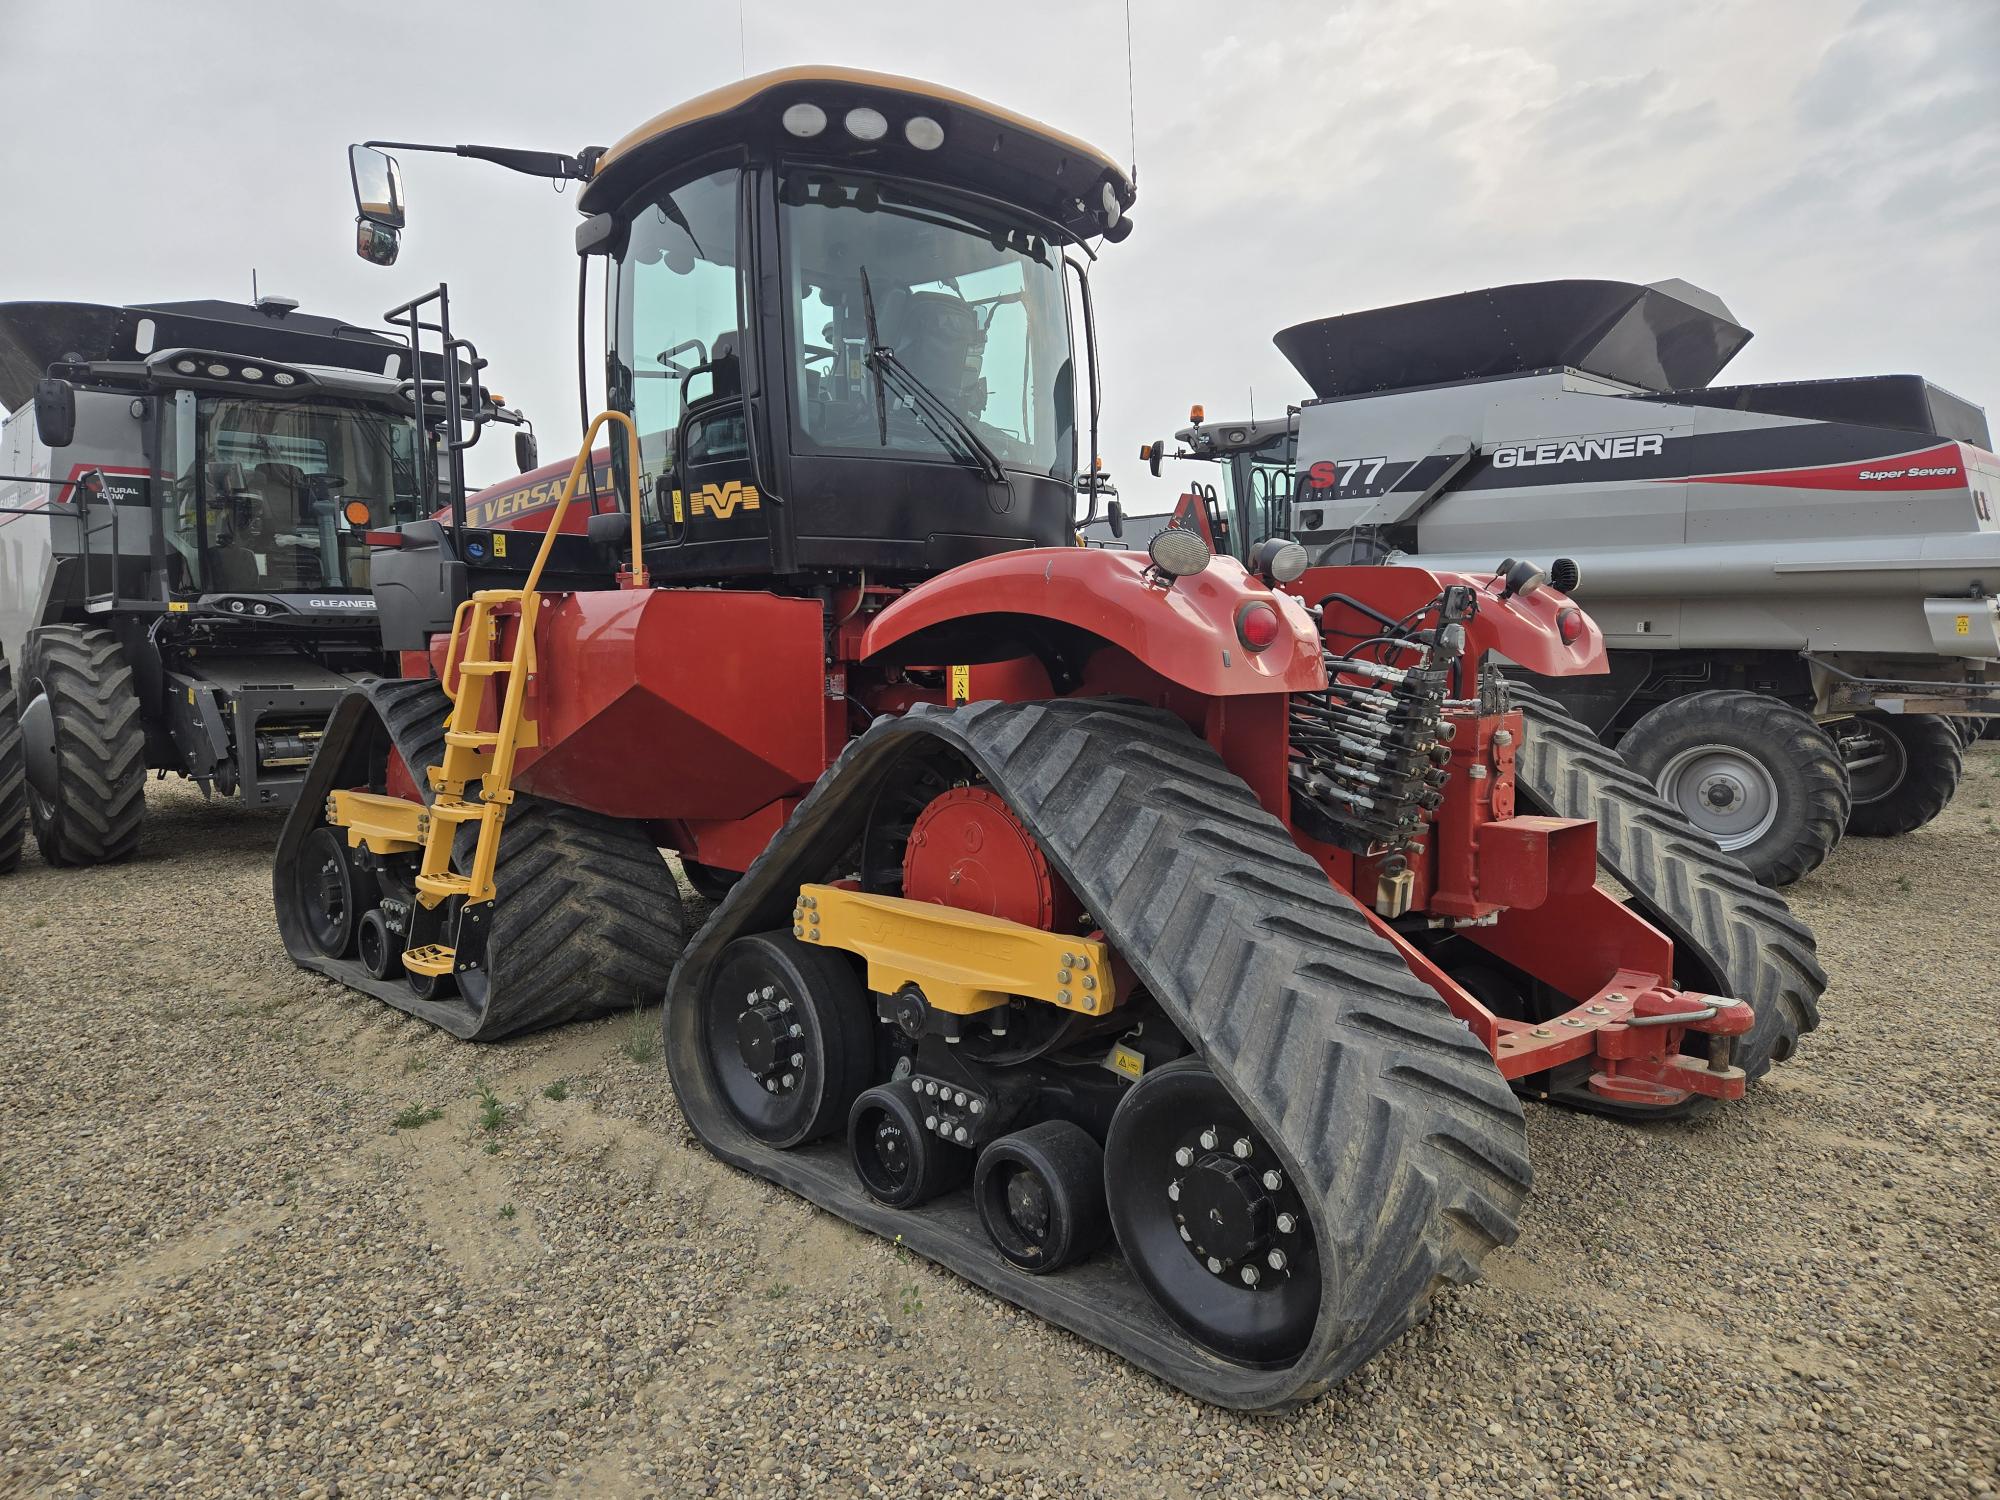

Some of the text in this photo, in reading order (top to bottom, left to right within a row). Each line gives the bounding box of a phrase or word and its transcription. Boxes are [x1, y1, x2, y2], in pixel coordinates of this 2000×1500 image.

[1492, 433, 1665, 469] GLEANER
[1310, 456, 1387, 489] S77
[1858, 467, 1958, 480] Super Seven
[484, 467, 615, 522] VERSAIL
[1305, 488, 1385, 499] TRITURA
[309, 599, 377, 609] GLEANER
